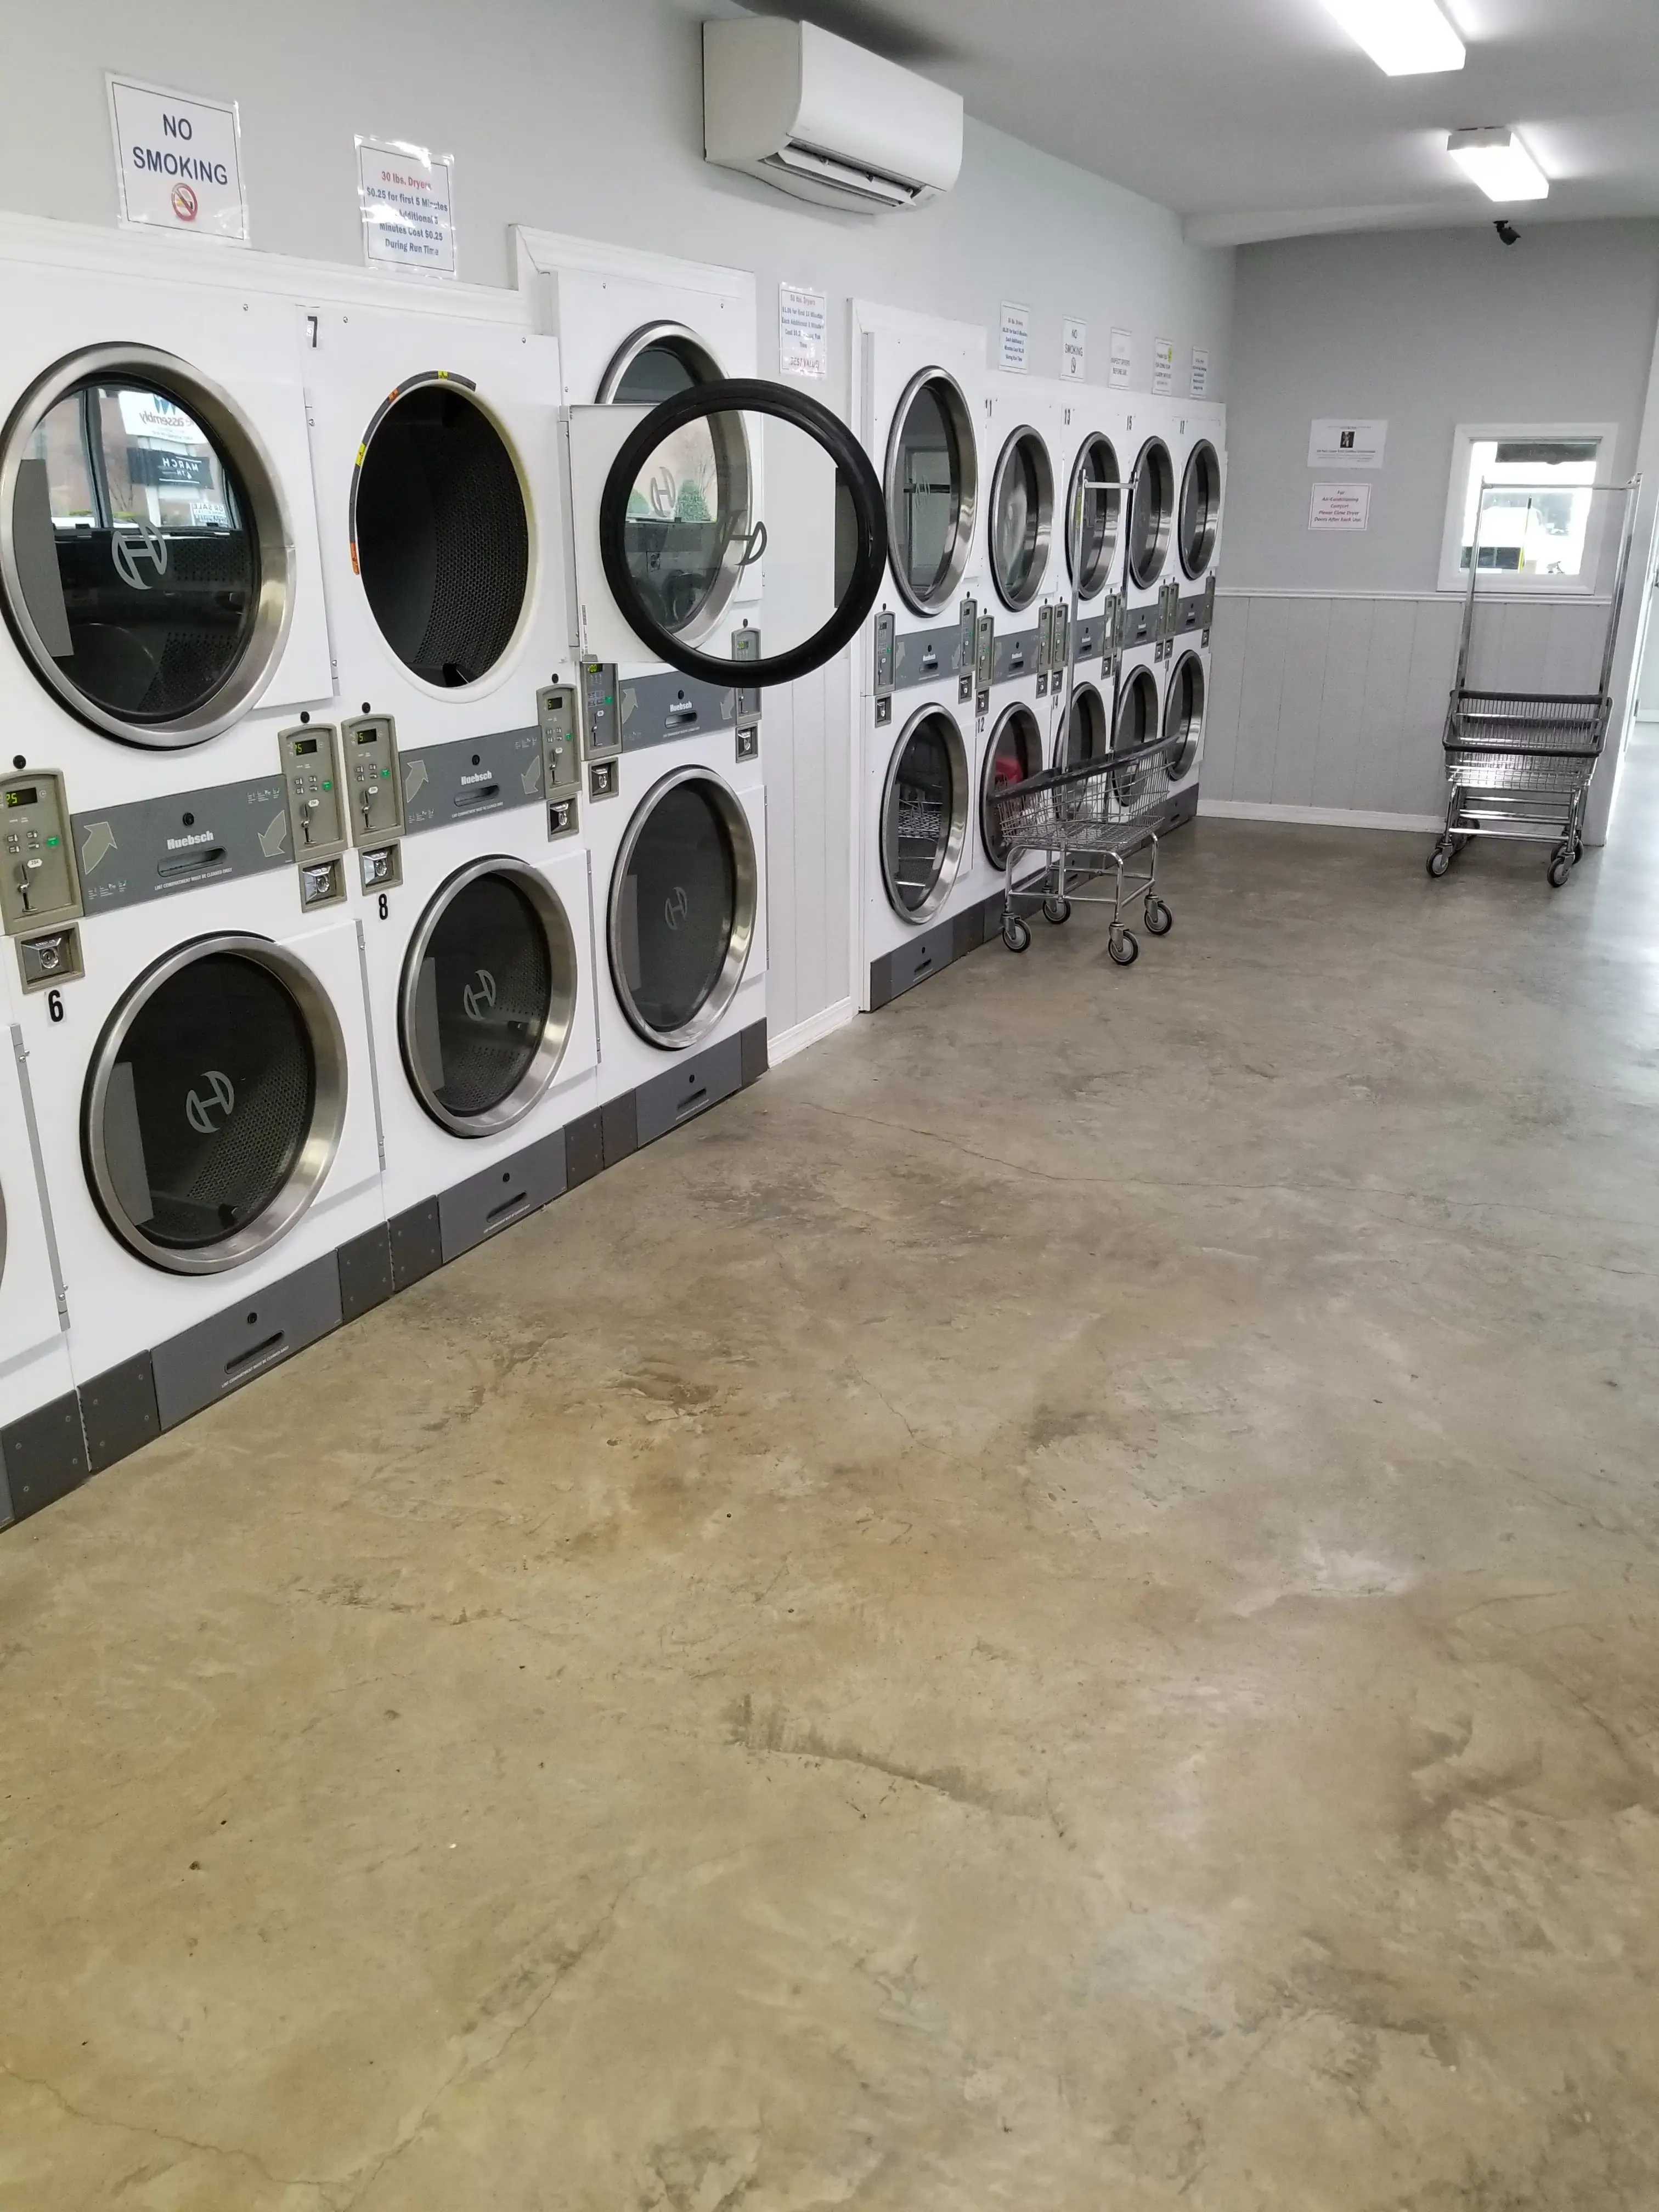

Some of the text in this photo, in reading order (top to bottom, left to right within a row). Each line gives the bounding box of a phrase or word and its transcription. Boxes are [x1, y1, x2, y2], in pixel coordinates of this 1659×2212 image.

[163, 114, 192, 140] NO
[133, 146, 228, 185] SMOKING
[382, 171, 432, 190] 30 lbs. Dryers
[366, 186, 386, 199] $0.25
[388, 191, 398, 202] for
[399, 193, 414, 205] first
[416, 197, 420, 206] 5
[380, 223, 443, 241] Minutes Cost $0.25
[386, 238, 438, 256] During Run Time
[308, 316, 318, 347] 7
[1053, 695, 1058, 710] 14
[978, 717, 985, 733] 12
[461, 770, 492, 785] Huebsch
[167, 831, 214, 850] Huebsch
[379, 894, 388, 920] 8
[48, 989, 64, 1022] 6
